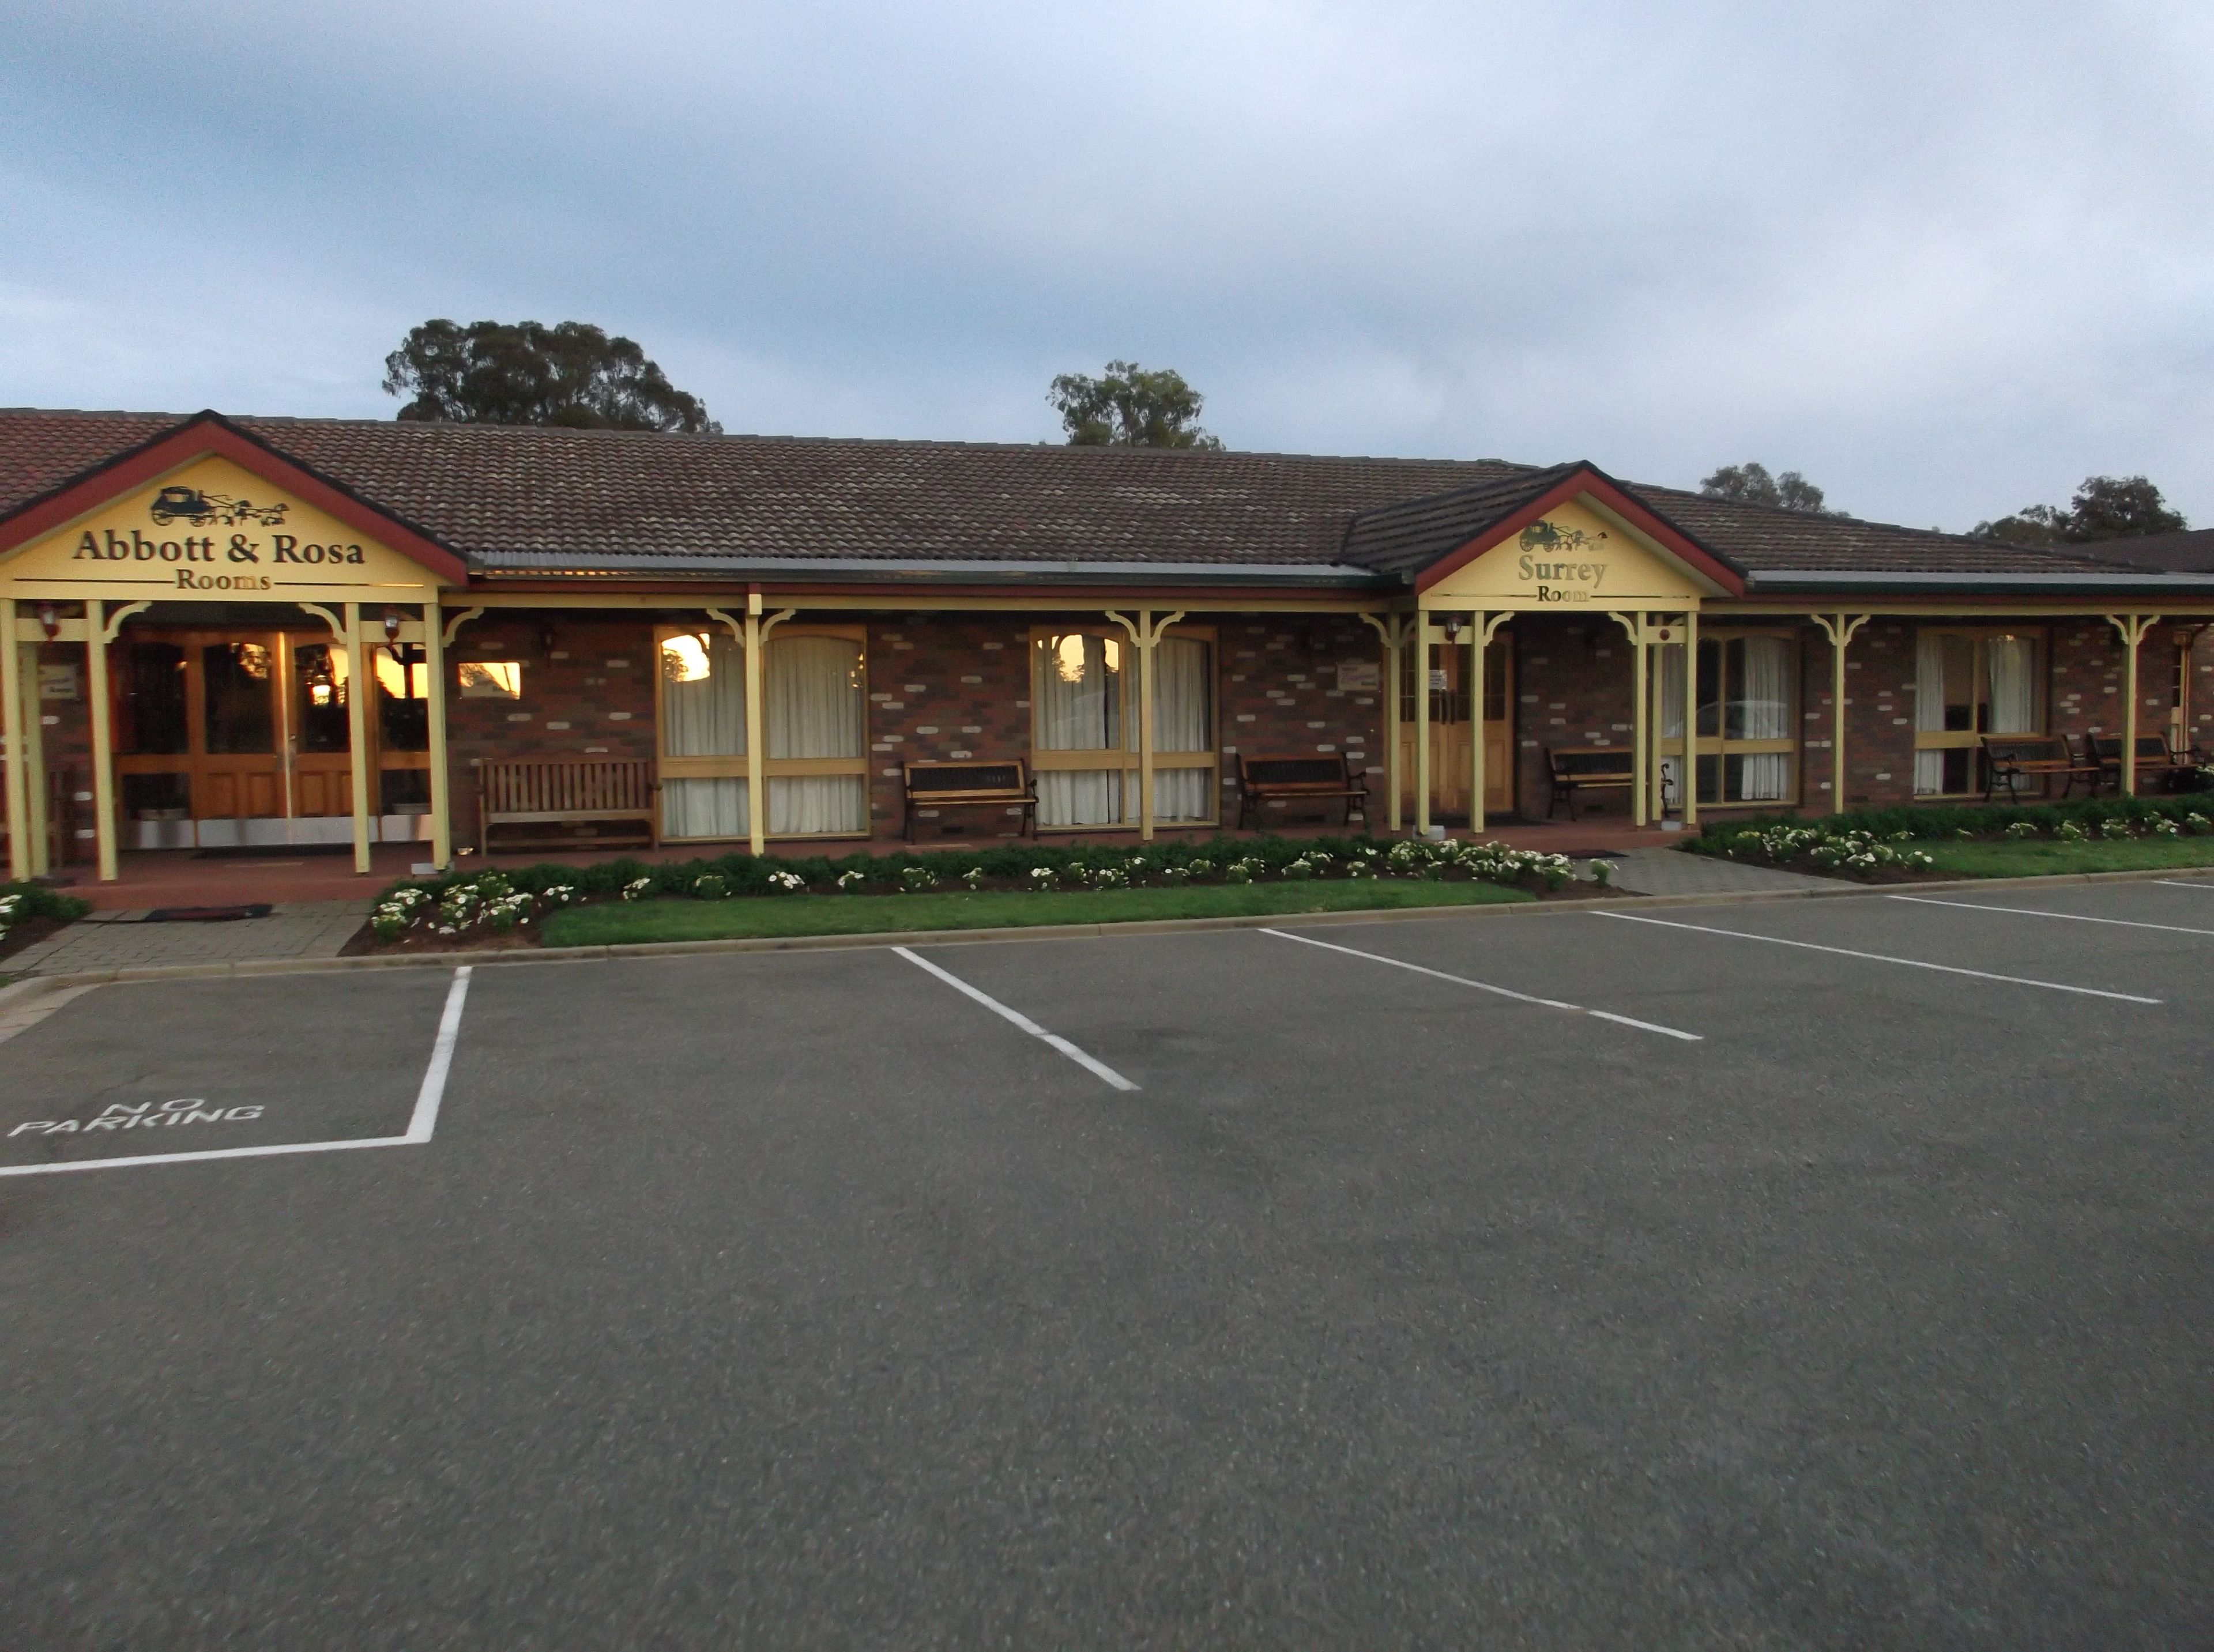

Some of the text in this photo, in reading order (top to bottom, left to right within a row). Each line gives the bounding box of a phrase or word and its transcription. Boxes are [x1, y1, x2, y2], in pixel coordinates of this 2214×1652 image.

[72, 529, 366, 564] Abbott & Rosa
[176, 568, 272, 590] Rooms
[1519, 555, 1607, 589] Surrey
[1537, 585, 1590, 602] Room
[7, 1104, 265, 1137] PARKING
[100, 1098, 205, 1117] NO
